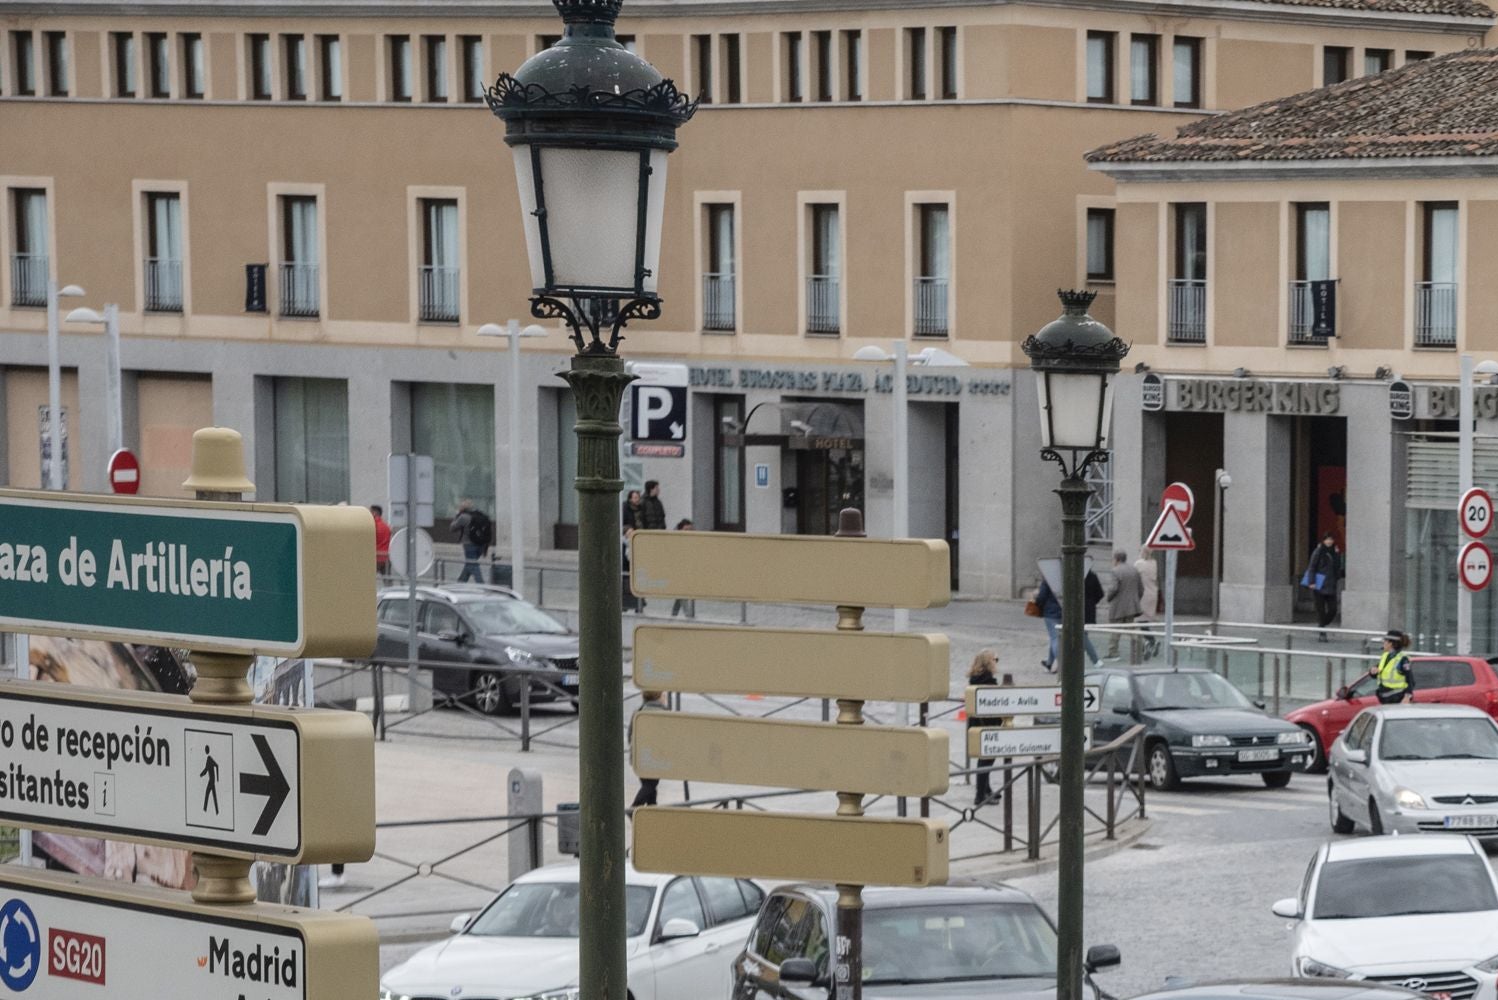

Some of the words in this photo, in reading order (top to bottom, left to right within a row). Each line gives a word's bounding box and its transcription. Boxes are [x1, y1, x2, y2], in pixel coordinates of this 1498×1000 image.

[1143, 393, 1160, 402] KING
[1178, 379, 1273, 411] BURGER
[1275, 382, 1341, 414] KING
[1390, 401, 1410, 411] KING
[638, 387, 673, 438] P
[815, 438, 853, 449] HOTEL
[1468, 505, 1486, 521] 20
[58, 536, 97, 587] de
[106, 539, 252, 600] Artillería
[980, 698, 1009, 707] Madrid
[1016, 697, 1039, 706] Avila
[21, 714, 49, 752] de
[57, 725, 170, 770] recepción
[984, 733, 999, 742] AVE
[984, 744, 1017, 754] Estación
[1019, 744, 1052, 753] Guiomar
[0, 763, 89, 809] sitantes
[53, 935, 102, 978] SG20
[209, 936, 297, 988] Madrid
